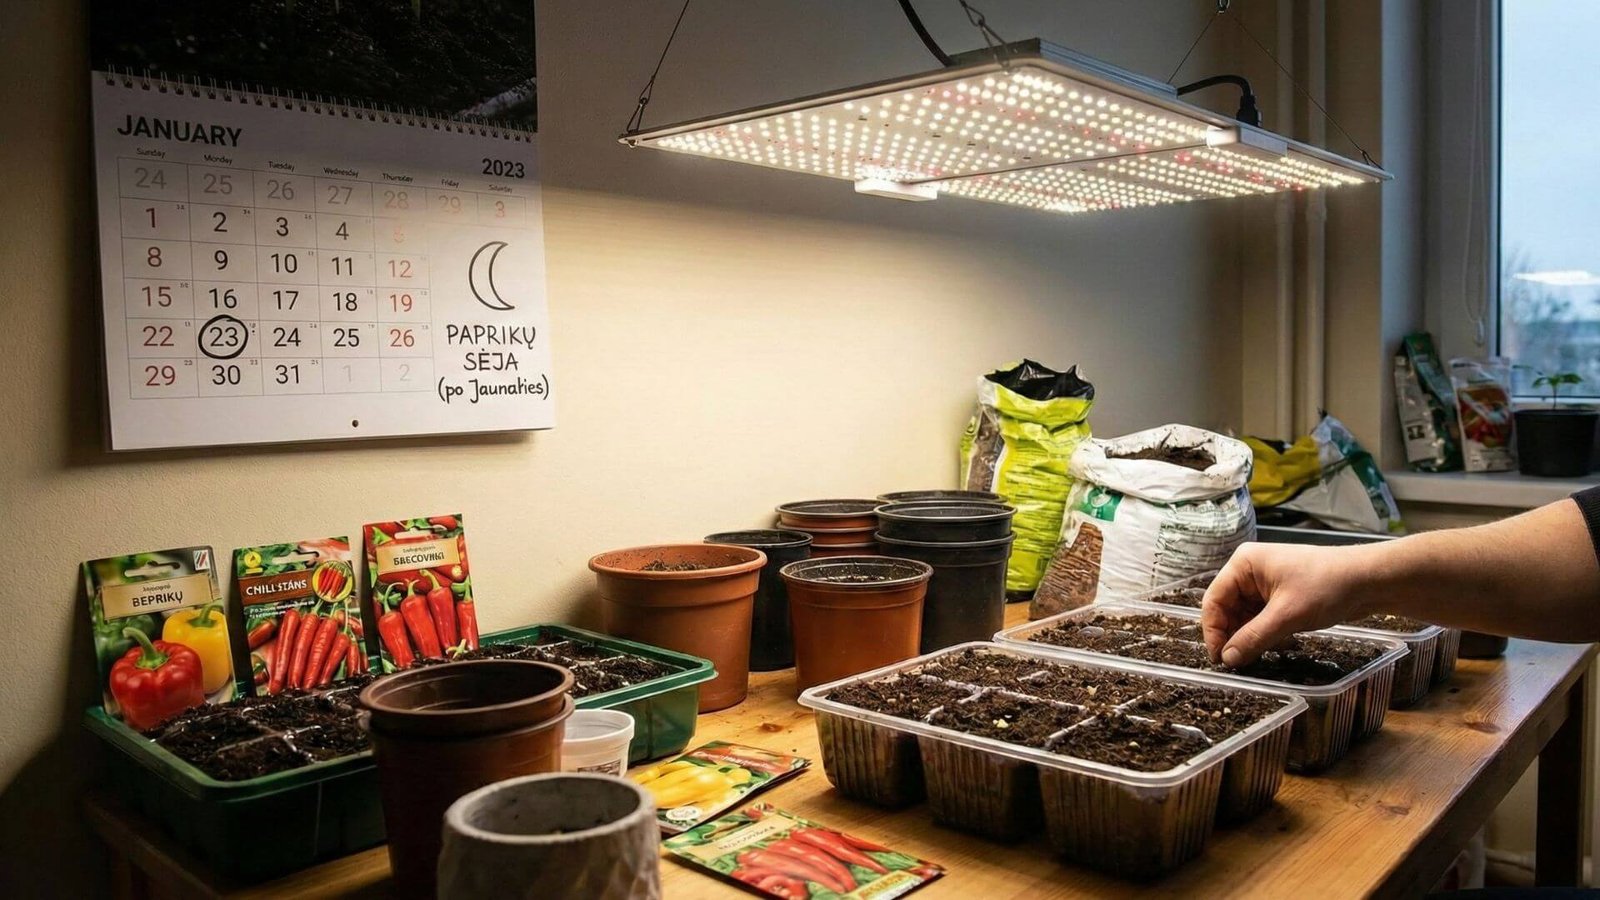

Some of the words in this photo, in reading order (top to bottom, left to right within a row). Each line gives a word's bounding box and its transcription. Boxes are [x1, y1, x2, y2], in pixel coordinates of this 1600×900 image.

[117, 114, 243, 147] JANUARY
[136, 147, 166, 159] Sunday
[203, 154, 233, 166] Monday
[268, 160, 295, 172] Tuesday
[323, 167, 359, 178] Wednesday
[482, 158, 525, 179] 2023
[134, 167, 167, 190] 24
[203, 173, 233, 195] 25
[266, 179, 295, 200] 26
[327, 185, 353, 205] 27
[384, 190, 409, 209] 28
[145, 207, 156, 228] 1
[212, 211, 228, 232] 2
[276, 216, 289, 237] 3
[335, 221, 349, 240] 4
[147, 246, 162, 267] 8
[214, 250, 228, 270] 9
[270, 253, 298, 273] 10
[331, 257, 353, 276] 11
[388, 260, 412, 278] 12
[141, 286, 172, 308] 15
[208, 288, 238, 309] 16
[273, 290, 299, 310] 17
[332, 292, 358, 312] 18
[389, 294, 413, 313] 19
[142, 325, 175, 347] 22
[209, 326, 239, 347] 23
[272, 327, 302, 348] 24
[333, 328, 360, 348] 25
[389, 328, 415, 348] 26
[446, 324, 536, 350] PAPRIKŲ
[463, 348, 519, 372] SĖJA
[145, 365, 176, 386] 29
[211, 364, 241, 386] 30
[275, 364, 300, 385] 31
[342, 364, 352, 383] 1
[399, 363, 412, 382] 2
[438, 376, 464, 404] (po
[132, 591, 183, 608] BEPRIKŲ
